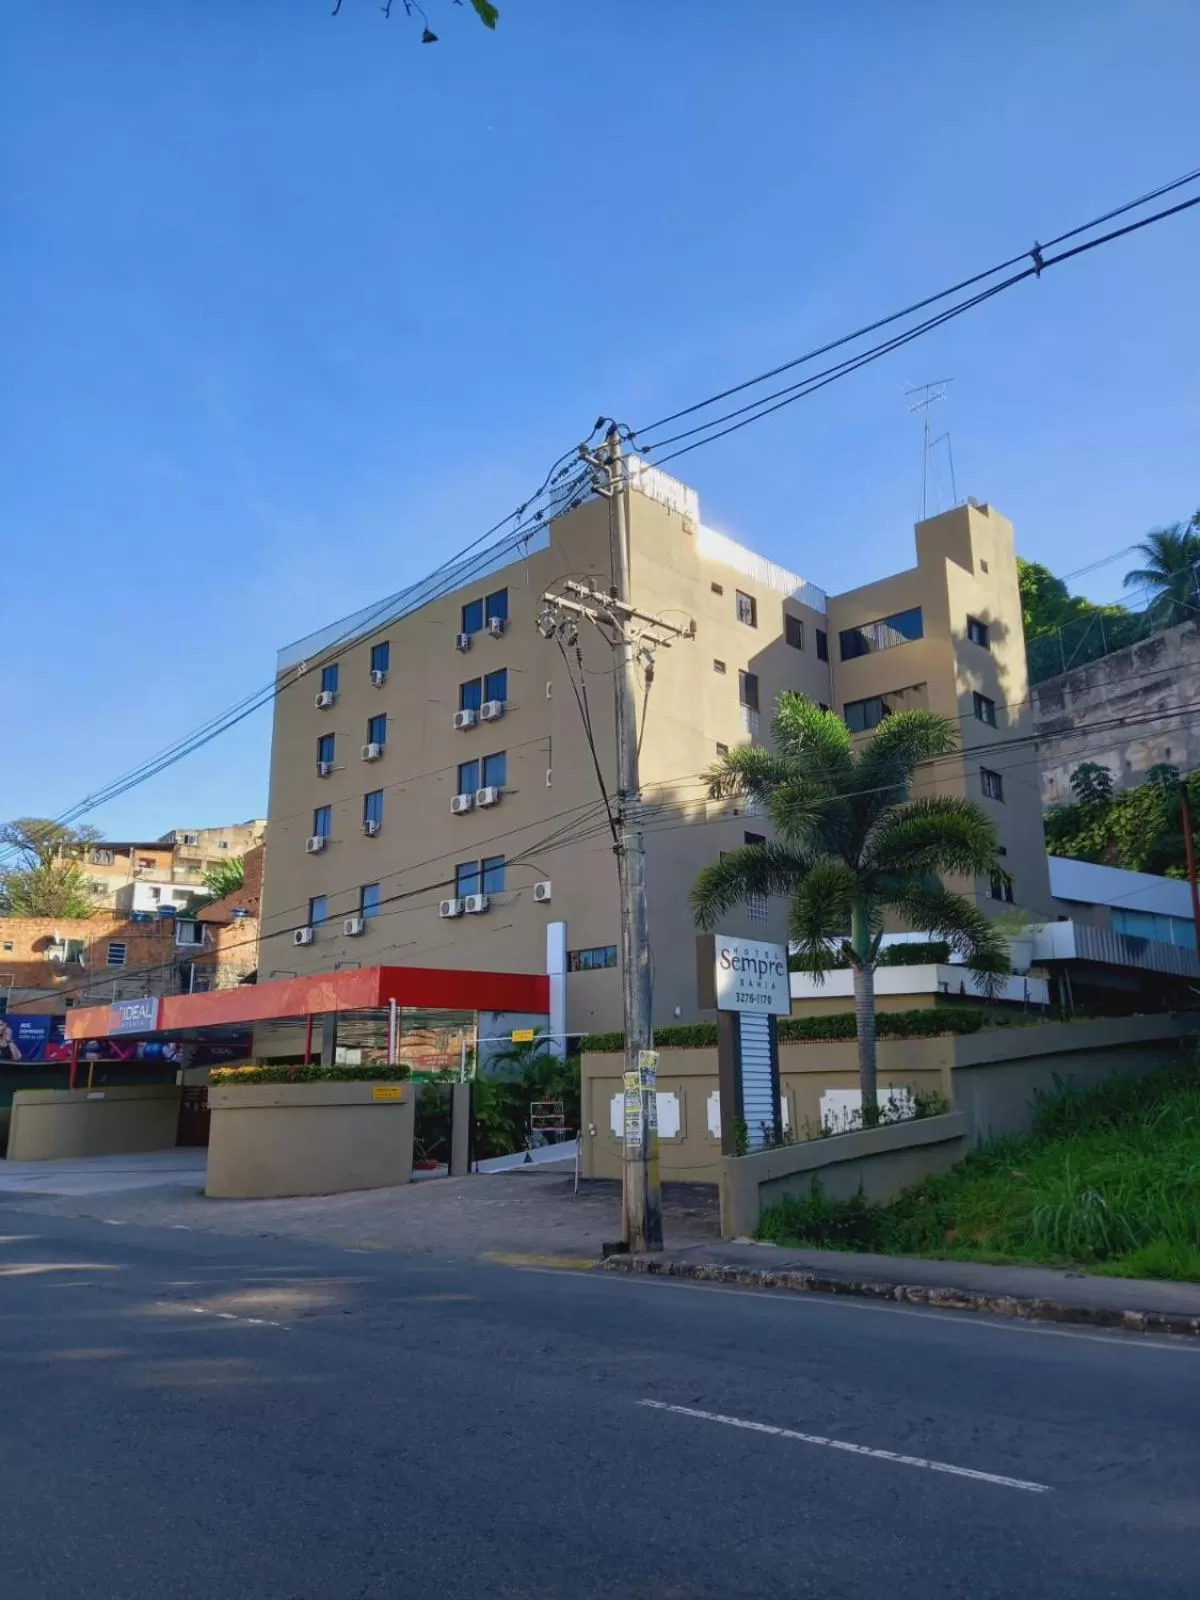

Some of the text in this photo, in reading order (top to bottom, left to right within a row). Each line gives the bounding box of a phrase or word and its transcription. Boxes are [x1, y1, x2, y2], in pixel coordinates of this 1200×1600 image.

[733, 947, 778, 959] HOTEL
[720, 949, 784, 979] Sempre
[122, 1003, 152, 1020] IDEAL
